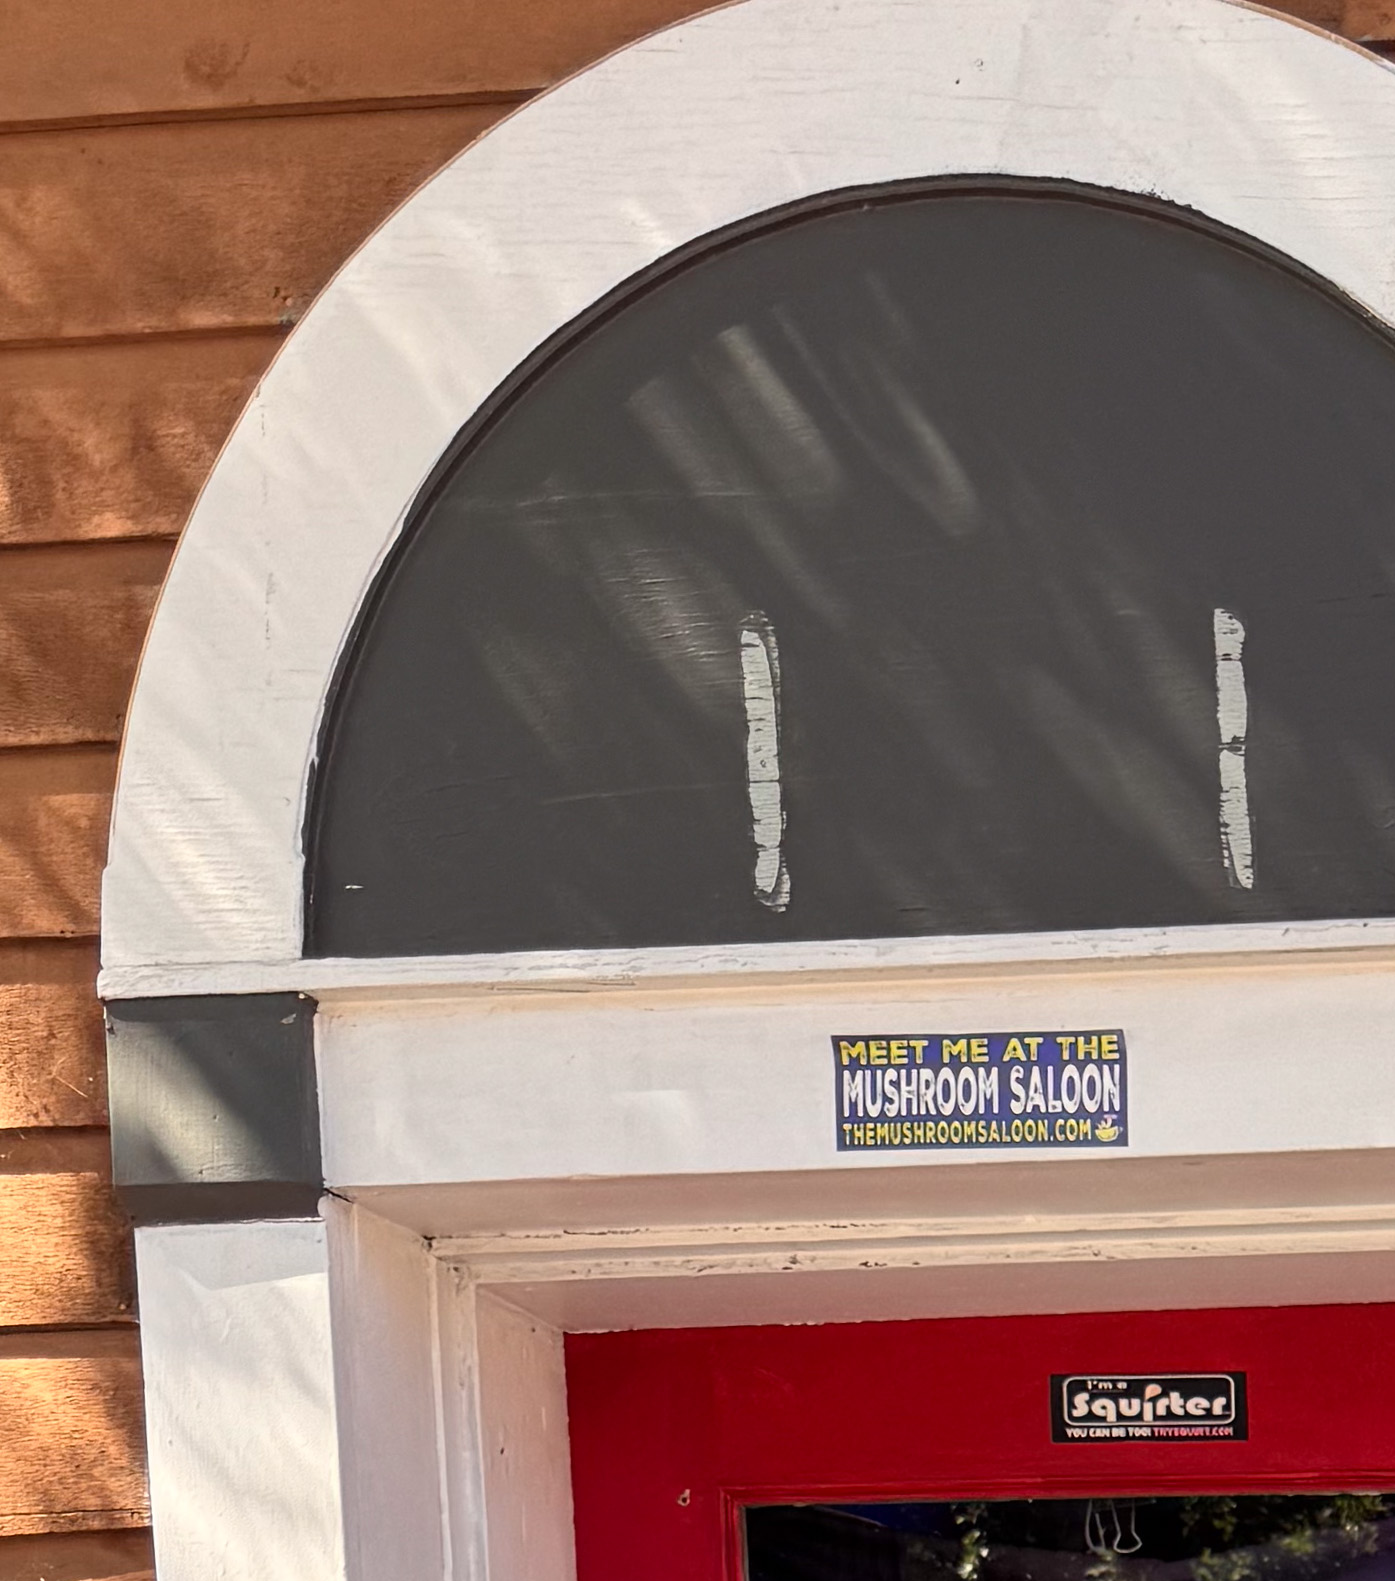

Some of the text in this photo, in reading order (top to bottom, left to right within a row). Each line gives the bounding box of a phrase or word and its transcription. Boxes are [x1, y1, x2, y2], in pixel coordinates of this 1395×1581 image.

[840, 1034, 1121, 1066] MEET ME AT THE
[842, 1064, 1121, 1118] MUSHROOM SALOON
[842, 1118, 1093, 1146] THEMUSHROOMSALOON.COM
[1072, 1383, 1228, 1422] Squirter
[1066, 1427, 1087, 1438] YOU
[1089, 1427, 1111, 1438] CAN
